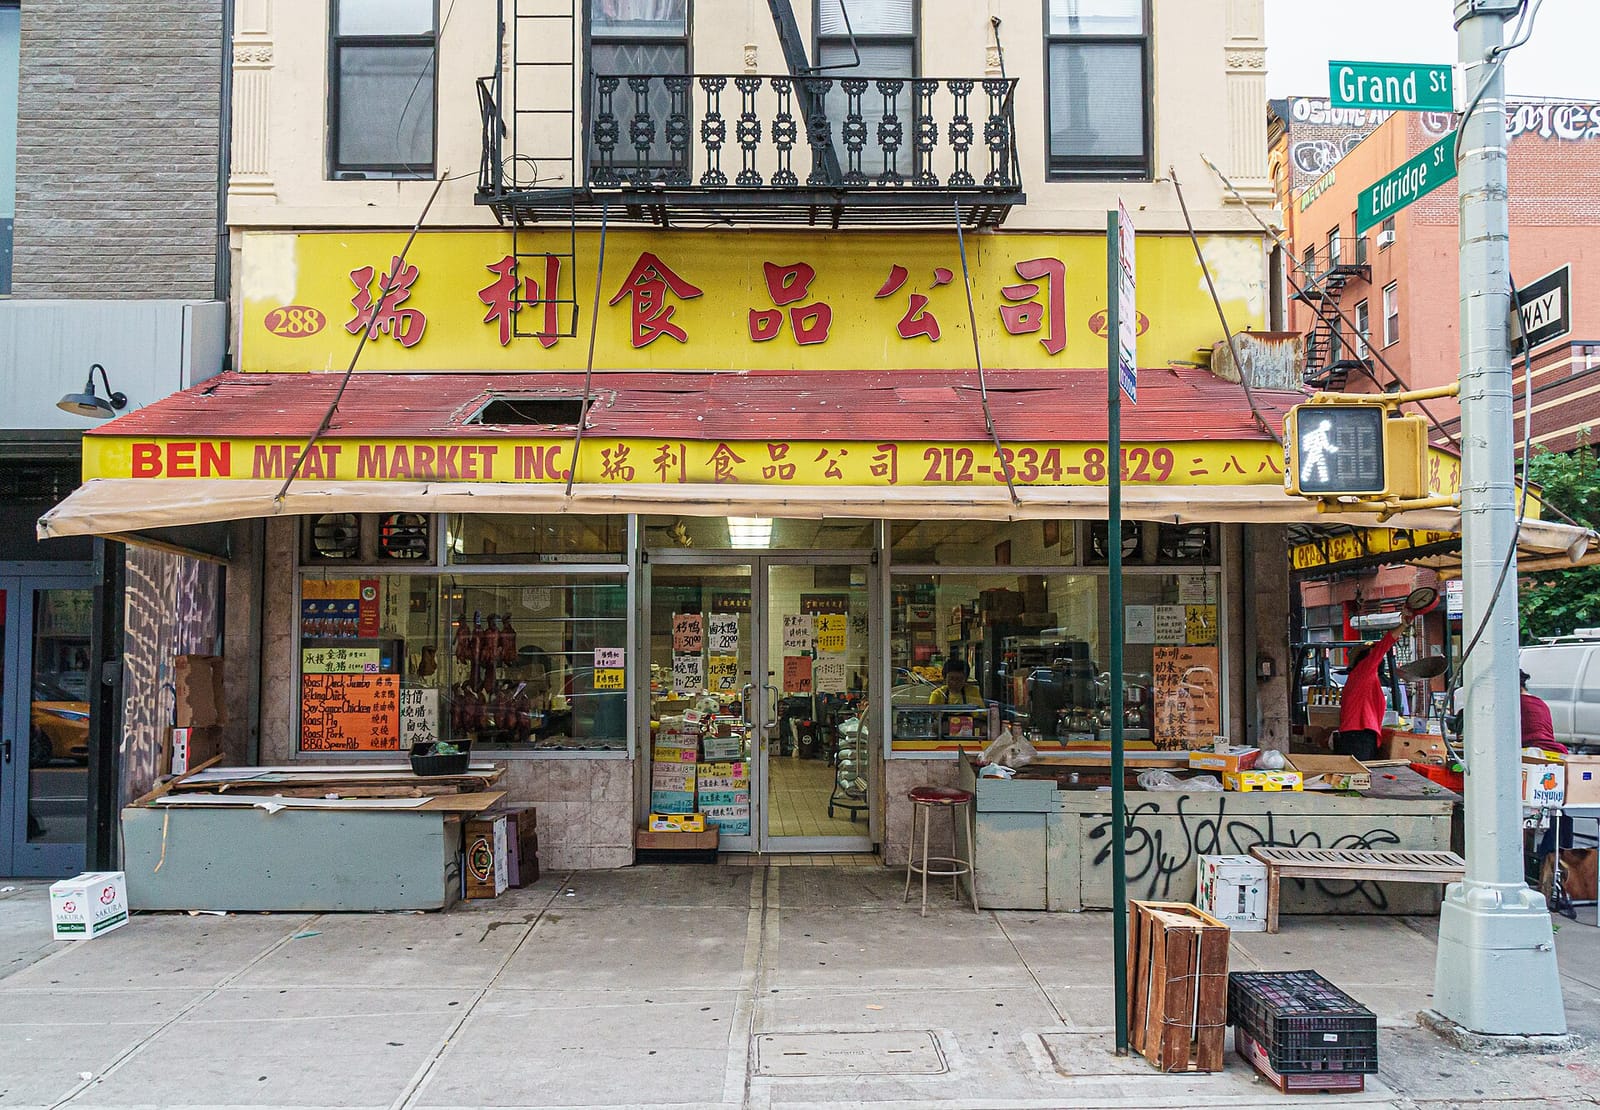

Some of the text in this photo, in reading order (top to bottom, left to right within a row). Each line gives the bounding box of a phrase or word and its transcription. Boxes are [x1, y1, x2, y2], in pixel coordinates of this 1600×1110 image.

[1338, 66, 1447, 105] Grand St
[1372, 145, 1445, 217] Eldridge St
[344, 250, 1067, 356] 瑞利食品公司
[1522, 294, 1554, 330] WAY
[272, 309, 320, 334] 288
[132, 442, 231, 479] BEN
[252, 445, 342, 479] MEAT
[357, 445, 498, 480] MARKET
[515, 446, 571, 480] INC.
[600, 443, 899, 485] 瑞利食品公司
[1189, 454, 1282, 477] 二八八
[303, 700, 319, 713] Soy
[341, 700, 371, 713] Chicken
[303, 712, 324, 726] Roast
[326, 713, 338, 727] Pig
[303, 726, 324, 739] Roast
[326, 726, 344, 739] Pork
[303, 739, 323, 750] BBQ
[95, 903, 123, 919] SAKURA
